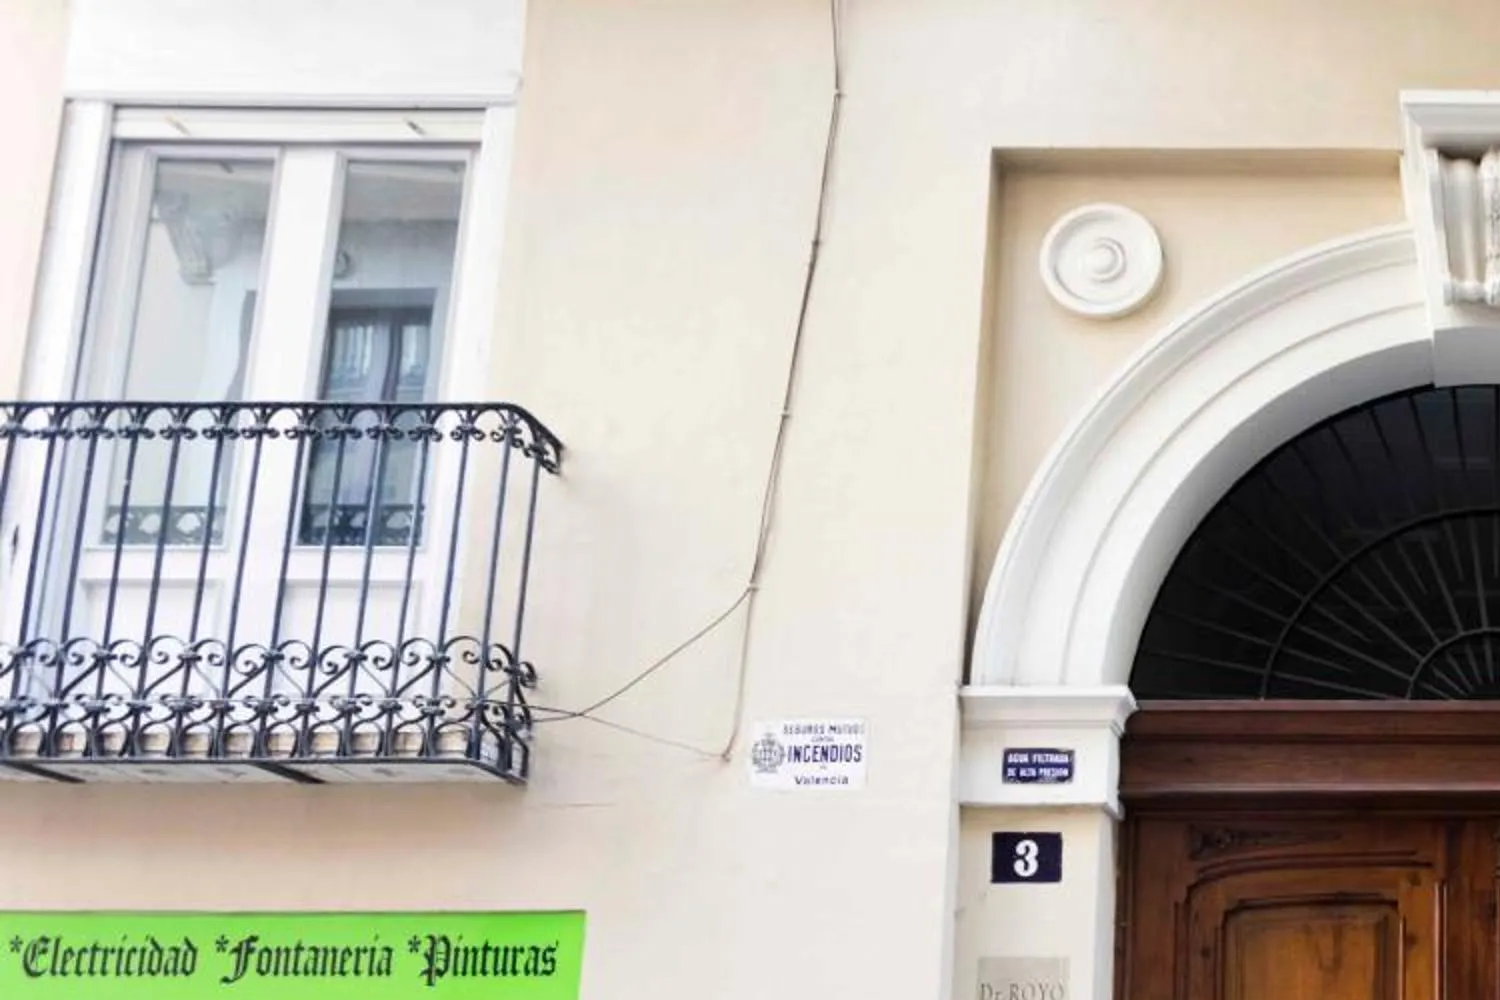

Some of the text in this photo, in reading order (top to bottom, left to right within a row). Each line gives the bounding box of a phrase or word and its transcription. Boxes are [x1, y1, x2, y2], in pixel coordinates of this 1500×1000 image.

[787, 744, 863, 763] INCENDIOS
[794, 775, 849, 785] Valencia
[1013, 839, 1040, 877] 3
